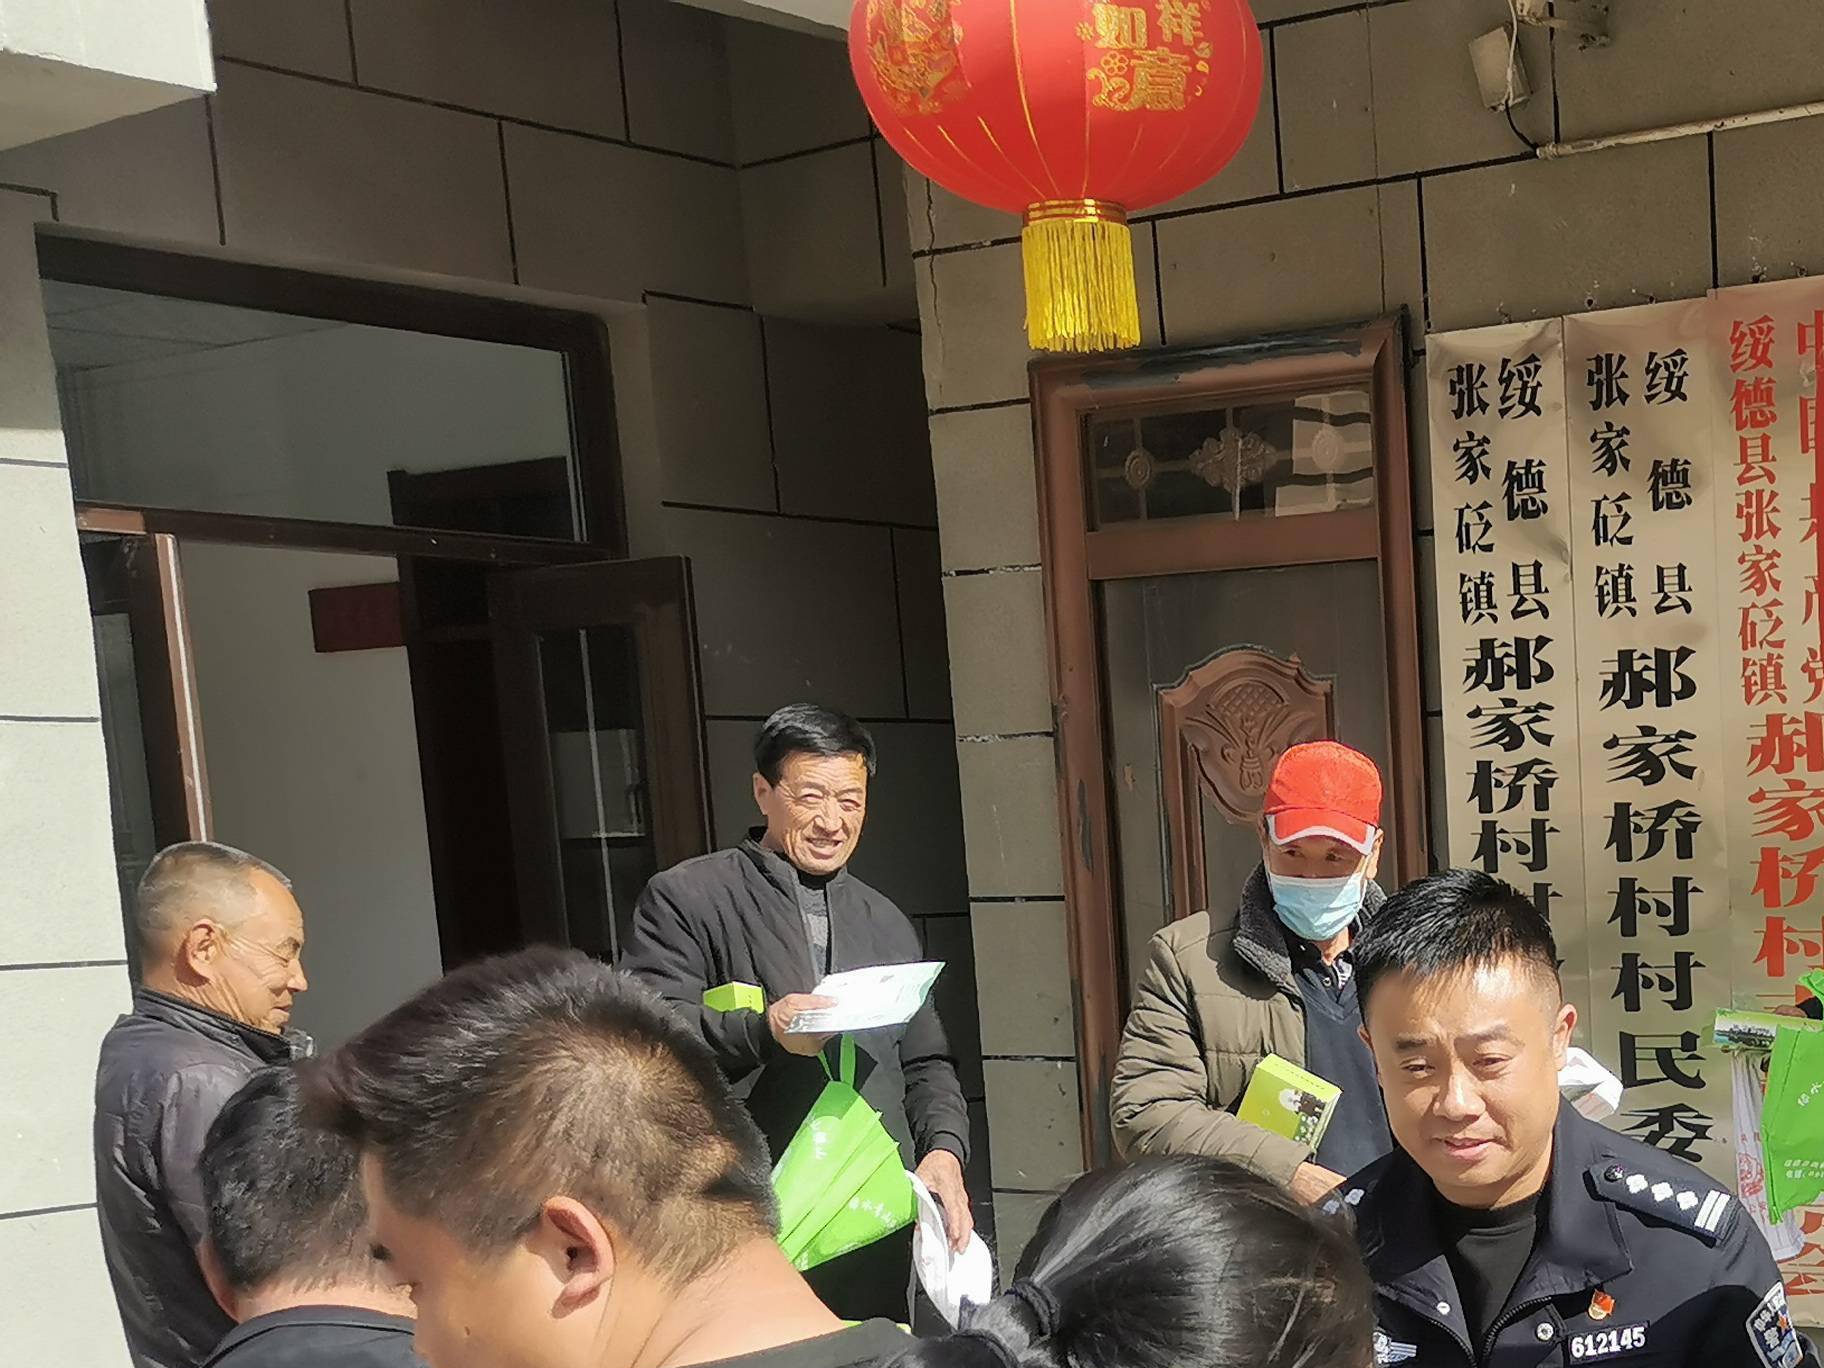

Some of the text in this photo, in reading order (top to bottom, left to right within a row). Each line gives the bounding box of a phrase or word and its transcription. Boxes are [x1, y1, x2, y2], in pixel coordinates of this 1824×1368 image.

[1448, 363, 1498, 625] 张家砭镇
[1498, 353, 1549, 620] 绥德县
[1586, 353, 1638, 620] 张家砭镇
[1644, 348, 1693, 616] 绥德县
[1729, 314, 1789, 706] 绥德县张家砭镇
[1571, 1326, 1646, 1359] 612145
